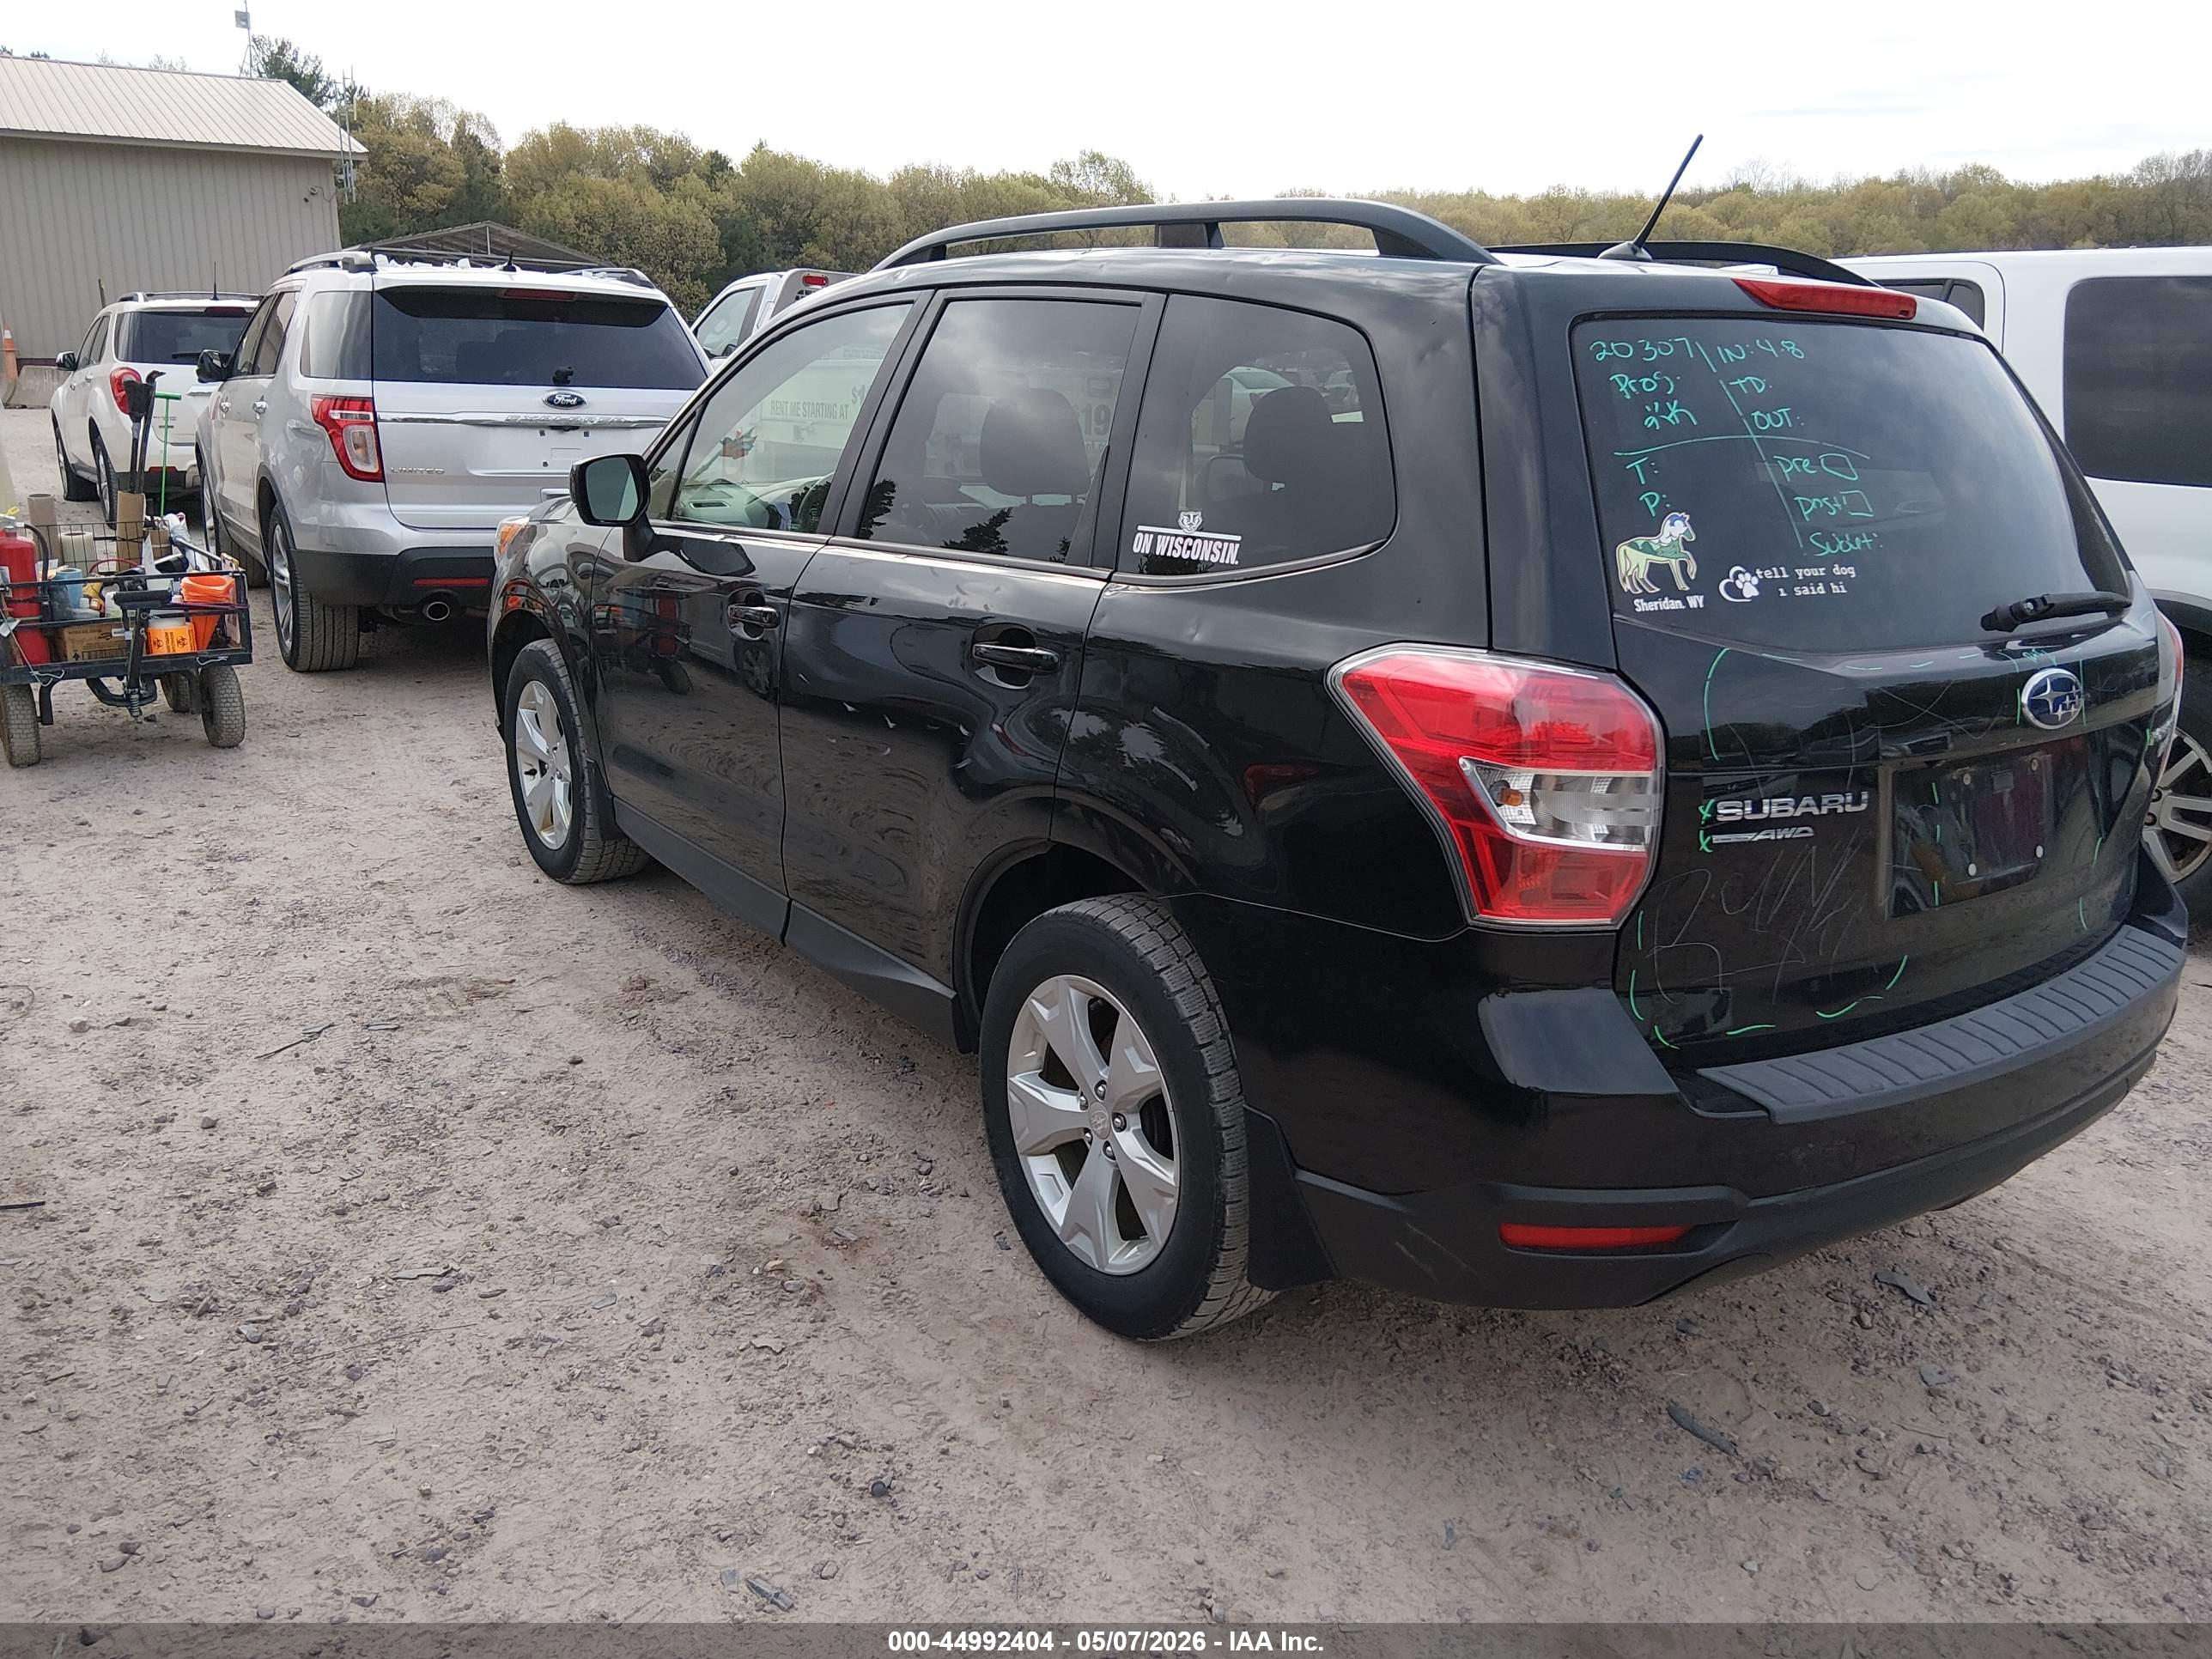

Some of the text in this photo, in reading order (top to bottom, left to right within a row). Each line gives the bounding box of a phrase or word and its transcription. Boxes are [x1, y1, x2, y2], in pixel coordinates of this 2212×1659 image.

[552, 393, 579, 406] Ford
[771, 400, 850, 420] RENT ME STARTING AT
[390, 466, 445, 475] LIMITED
[1133, 532, 1153, 555] ON
[1755, 563, 1857, 580] tell your dog
[1793, 585, 1826, 596] said
[1831, 581, 1848, 594] hi
[1686, 594, 1705, 610] WY
[1716, 791, 1869, 822] SUBARU
[1750, 825, 1814, 842] AWD
